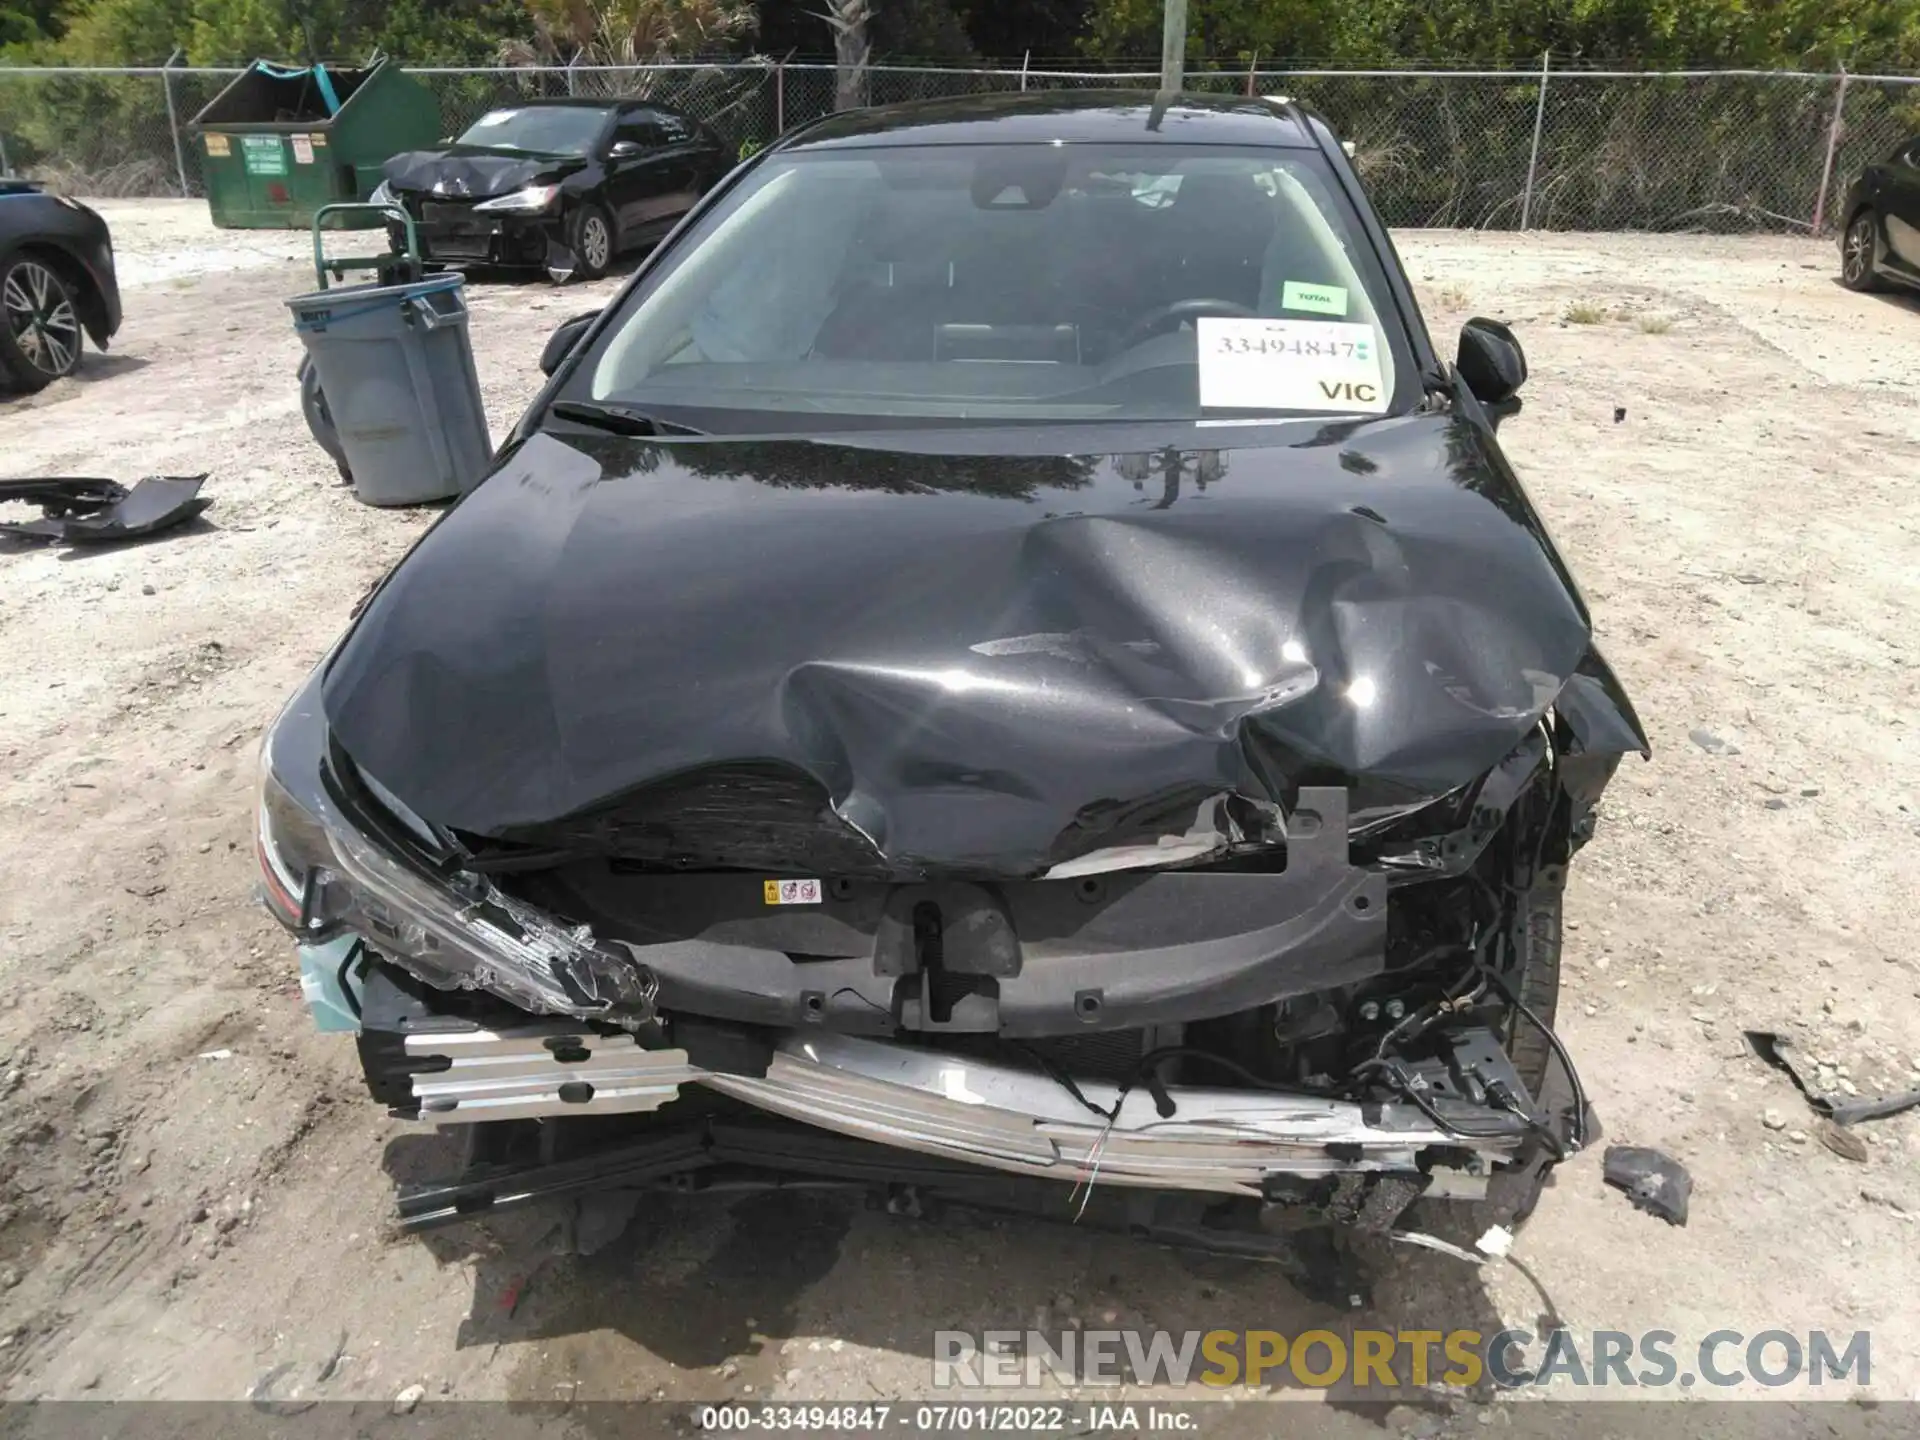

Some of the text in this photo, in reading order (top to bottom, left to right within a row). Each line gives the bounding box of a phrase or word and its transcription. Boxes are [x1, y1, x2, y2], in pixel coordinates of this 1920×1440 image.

[1297, 292, 1332, 303] TOTAL
[1217, 337, 1355, 357] 33494847
[1318, 380, 1377, 402] VIC
